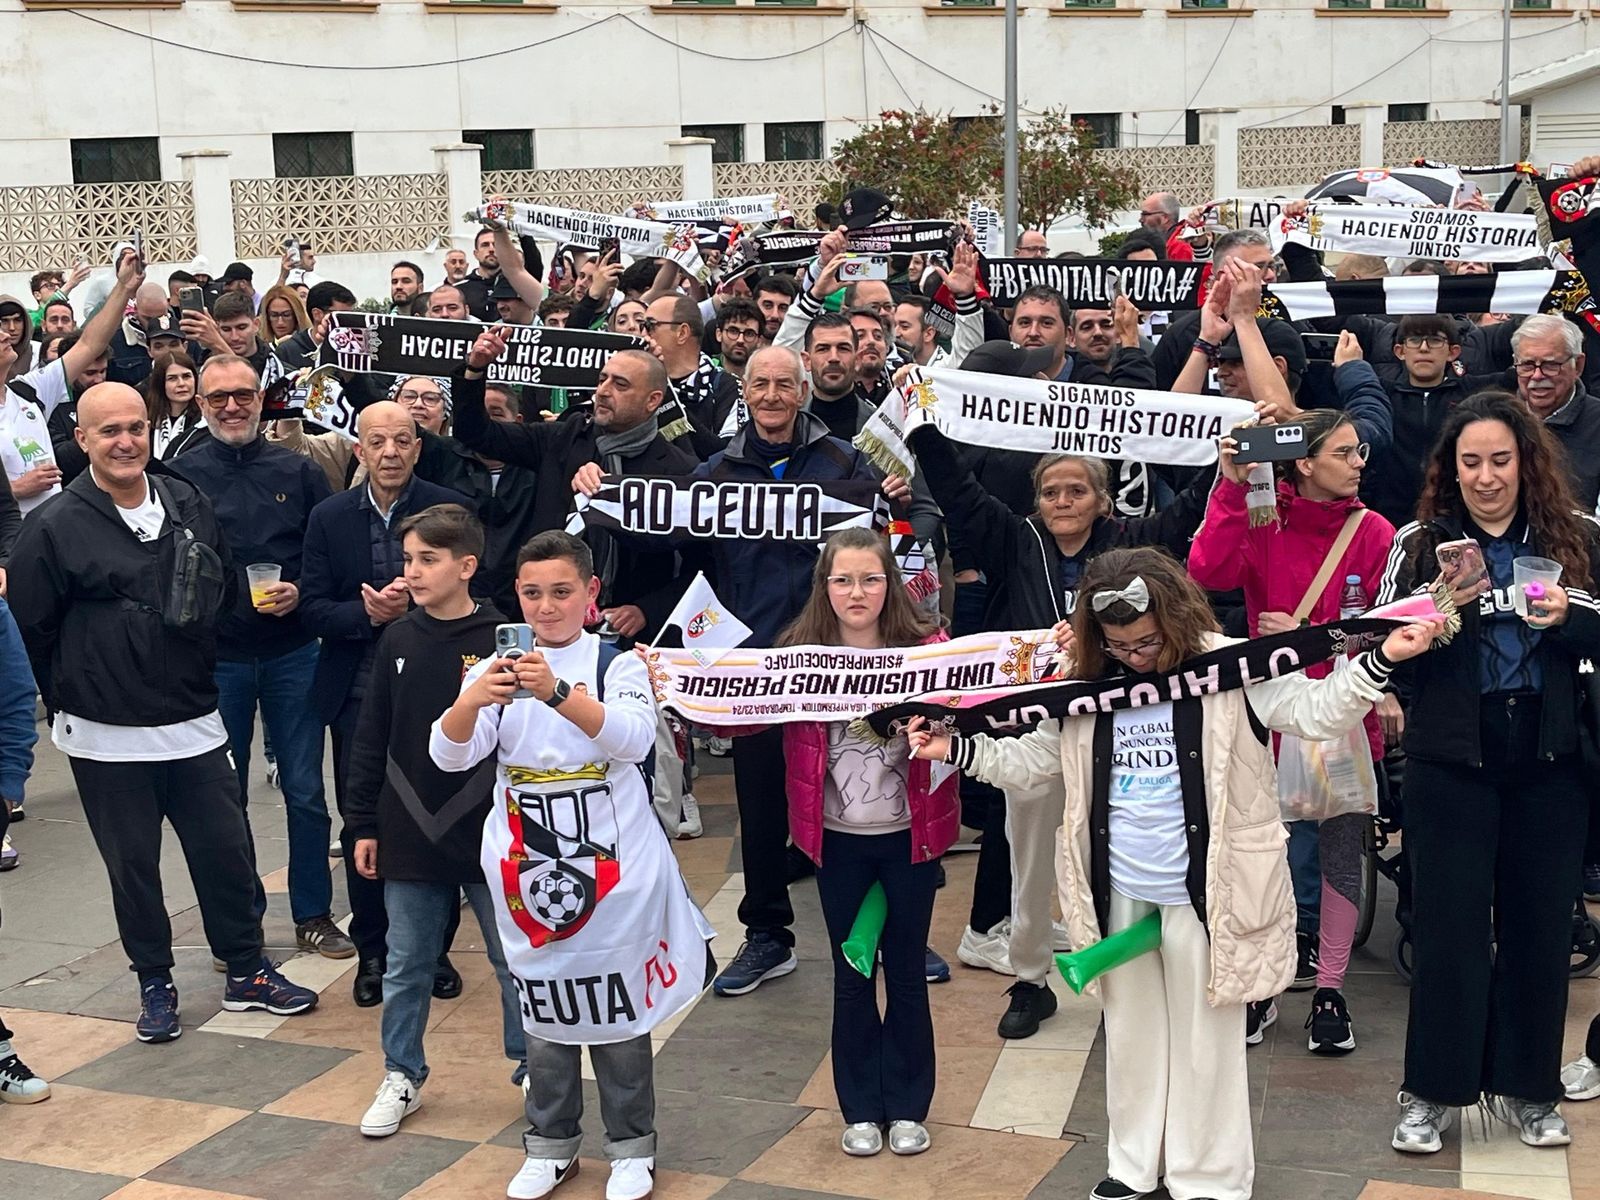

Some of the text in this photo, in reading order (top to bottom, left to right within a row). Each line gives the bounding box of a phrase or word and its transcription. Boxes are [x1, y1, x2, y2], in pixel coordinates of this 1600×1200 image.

[667, 203, 764, 219] HACIENDO HISTORIA
[698, 199, 730, 208] SIGAMOS
[570, 211, 613, 223] SIGAMOS
[1250, 202, 1281, 228] AD
[1410, 210, 1477, 227] SIGAMOS
[527, 210, 588, 233] HACIENDO
[592, 223, 650, 243] HISTORIA
[1341, 220, 1537, 248] HACIENDO HISTORIA
[1408, 242, 1461, 258] JUNTOS
[1048, 384, 1135, 407] SIGAMOS
[961, 394, 1223, 440] HACIENDO HISTORIA
[1051, 431, 1122, 454] JUNTOS
[620, 478, 823, 540] AD CEUTA
[765, 652, 904, 671] #SIEMPREADCEUTAFC
[675, 662, 995, 700] UNA ILUSIÓN NOS PERSIGUE
[732, 703, 754, 716] 23/24
[754, 703, 796, 715] TEMPORADA
[802, 702, 849, 713] HYPERMOTION
[850, 702, 867, 712] LIGA
[1120, 737, 1162, 749] NUNCA
[1138, 776, 1172, 785] LALIGA
[544, 878, 574, 895] FC
